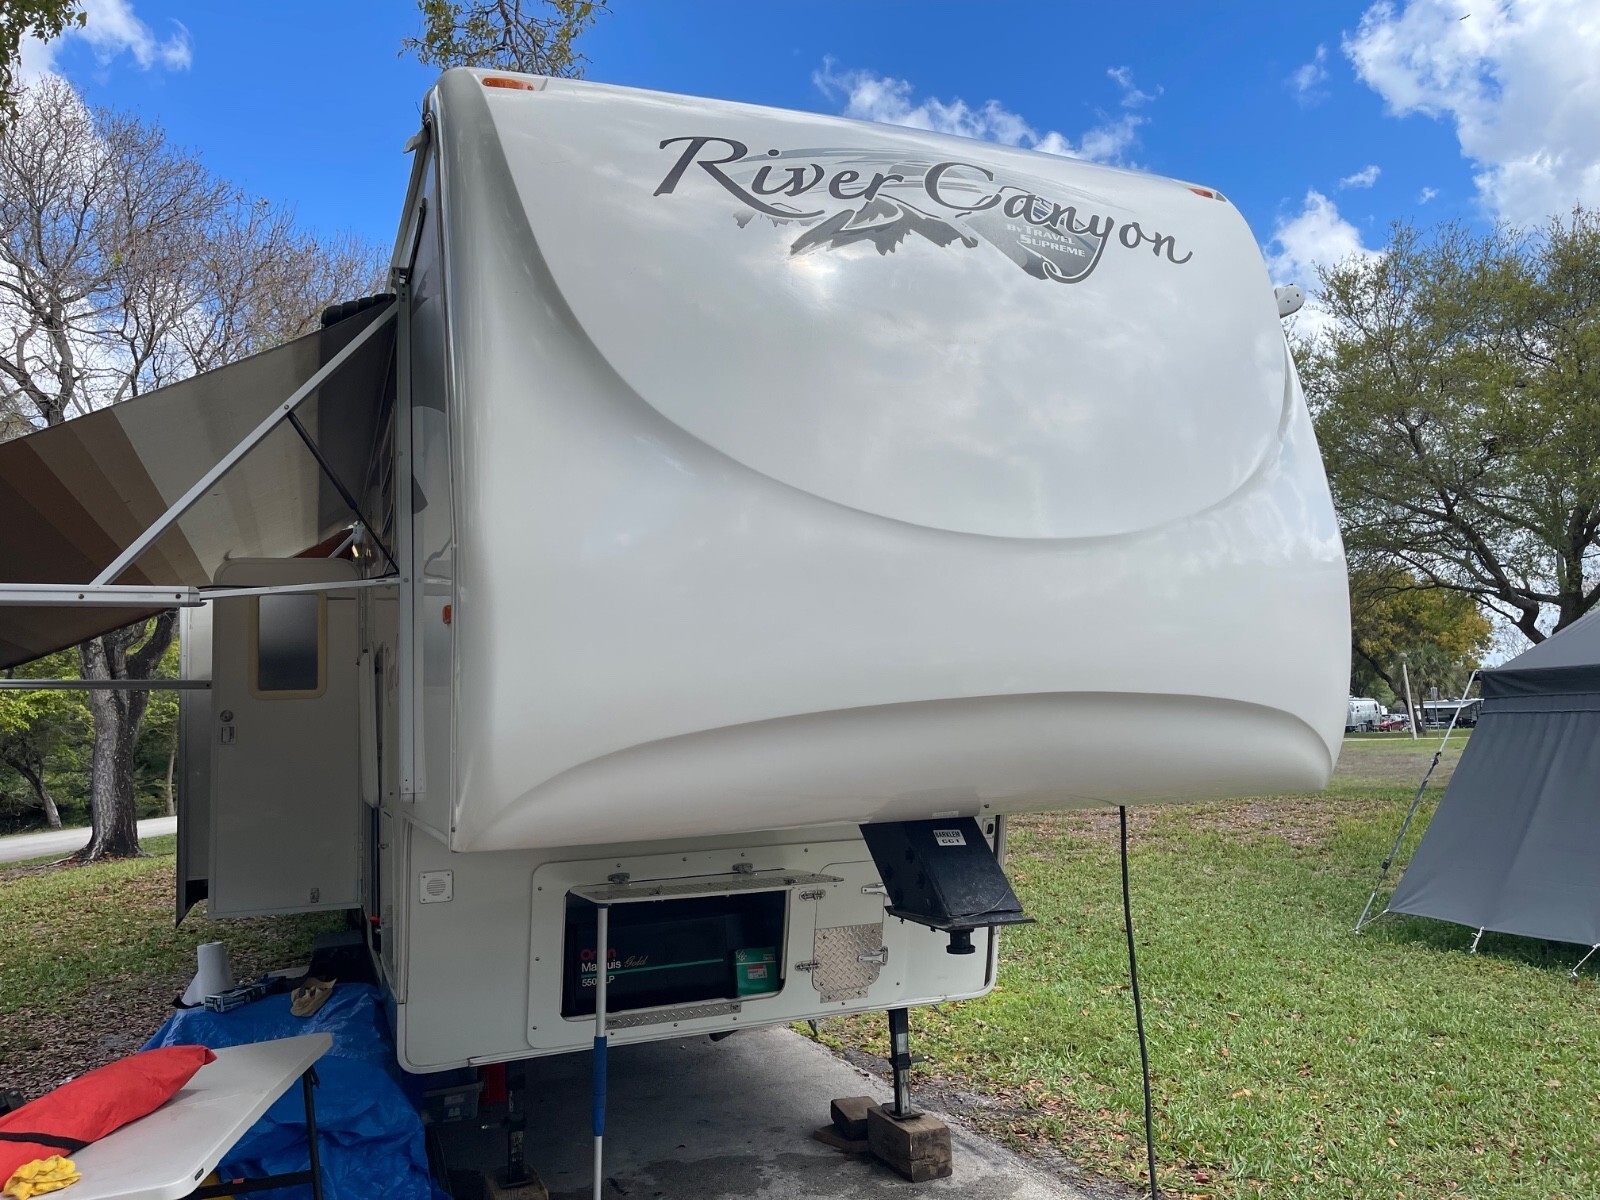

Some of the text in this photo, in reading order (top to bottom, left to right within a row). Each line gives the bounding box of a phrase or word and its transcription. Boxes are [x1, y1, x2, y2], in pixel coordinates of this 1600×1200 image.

[653, 136, 1193, 284] River Canyon
[1020, 234, 1086, 257] SUPREME
[1022, 225, 1075, 245] TRAVEL
[581, 959, 622, 973] Mauis
